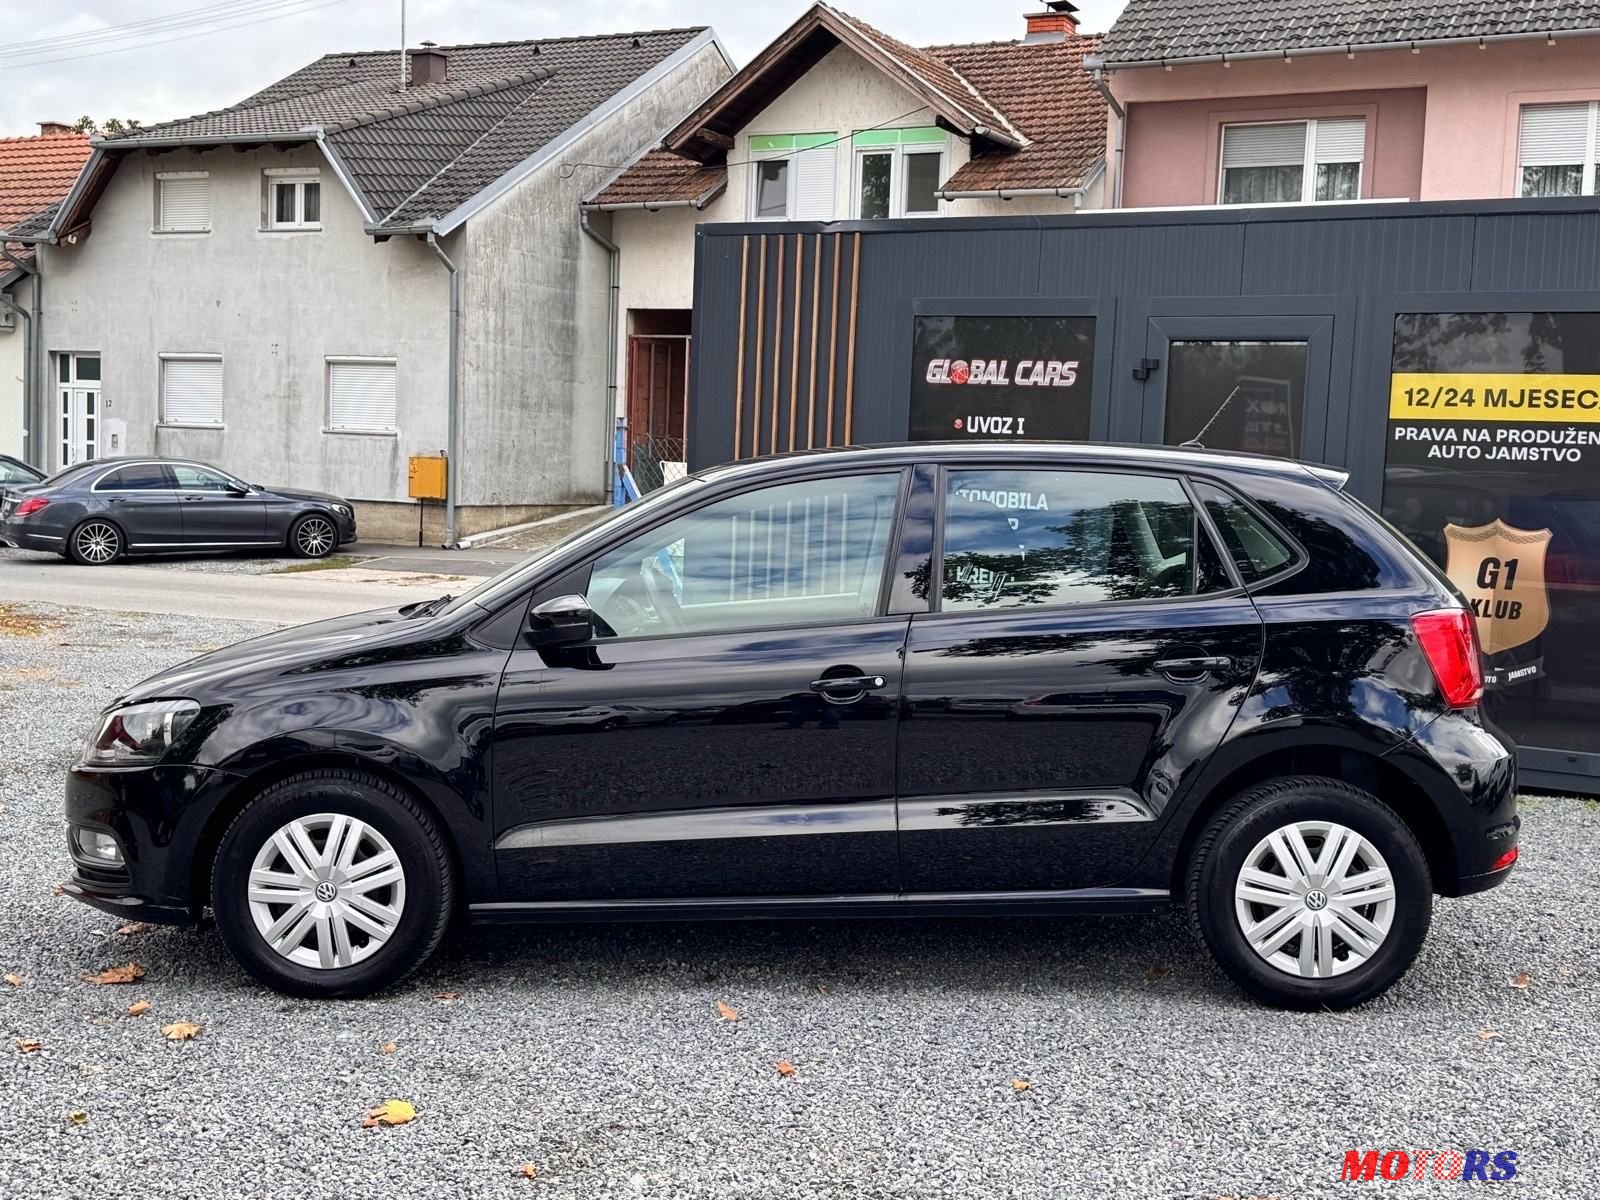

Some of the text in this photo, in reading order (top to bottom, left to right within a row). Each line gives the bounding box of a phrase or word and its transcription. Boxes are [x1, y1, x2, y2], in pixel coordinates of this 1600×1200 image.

[926, 358, 1079, 387] GLOBAL CARS
[1404, 386, 1600, 410] 12/24 MJESEC
[967, 415, 1025, 435] UVOZ I
[1394, 427, 1458, 441] PRAVA
[1462, 428, 1491, 442] NA
[1427, 445, 1582, 462] AUTO JAMSTVO
[1476, 557, 1520, 590] G1
[1470, 598, 1522, 620] KLUB
[1507, 665, 1537, 682] JAMSTVO
